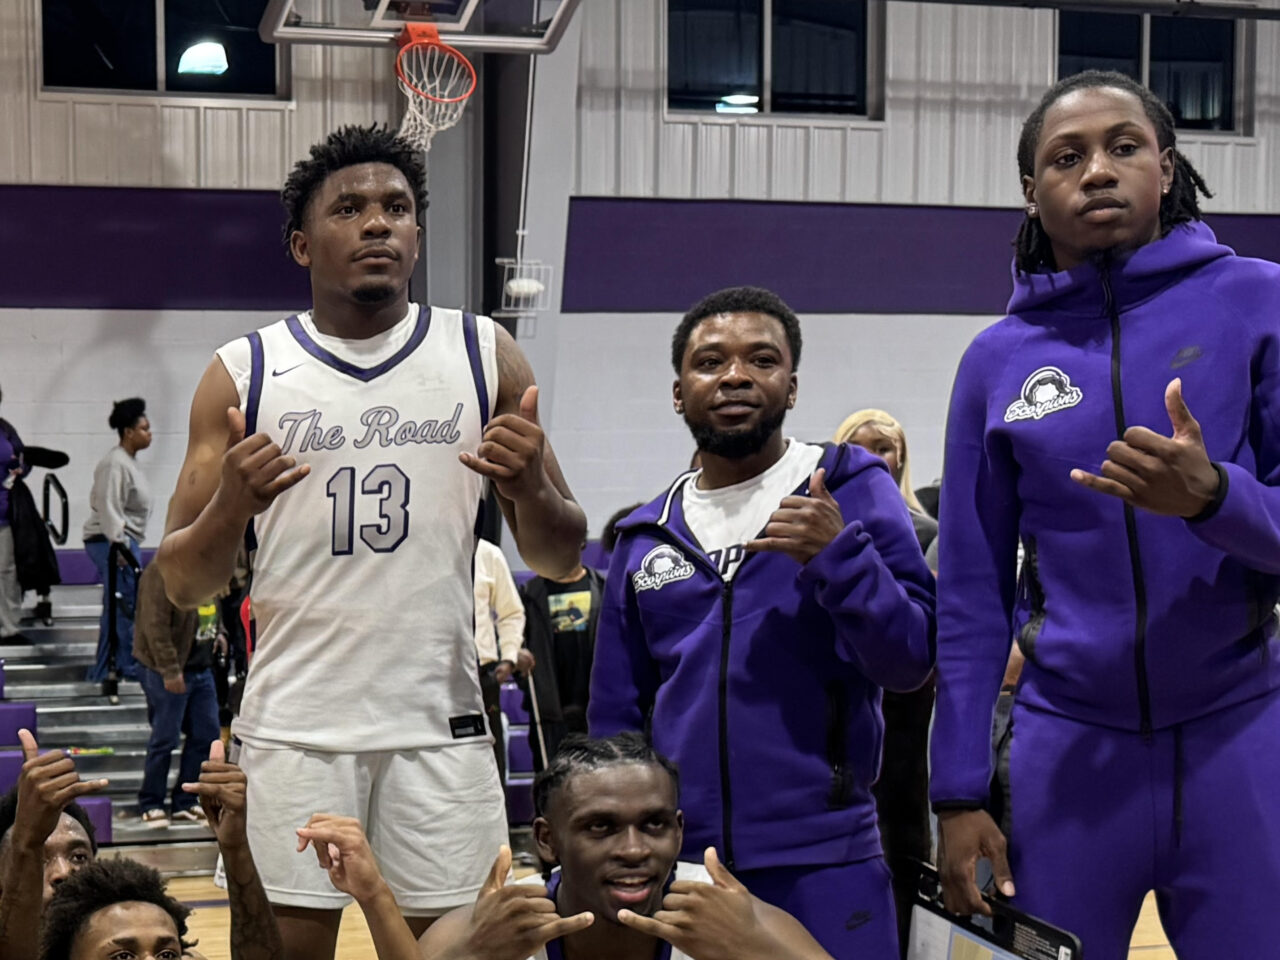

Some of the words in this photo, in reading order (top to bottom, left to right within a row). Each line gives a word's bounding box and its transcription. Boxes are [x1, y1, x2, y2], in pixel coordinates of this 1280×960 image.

[278, 409, 346, 455] The
[353, 402, 464, 448] Road
[1006, 387, 1079, 420] Scorpions
[326, 463, 411, 556] 13
